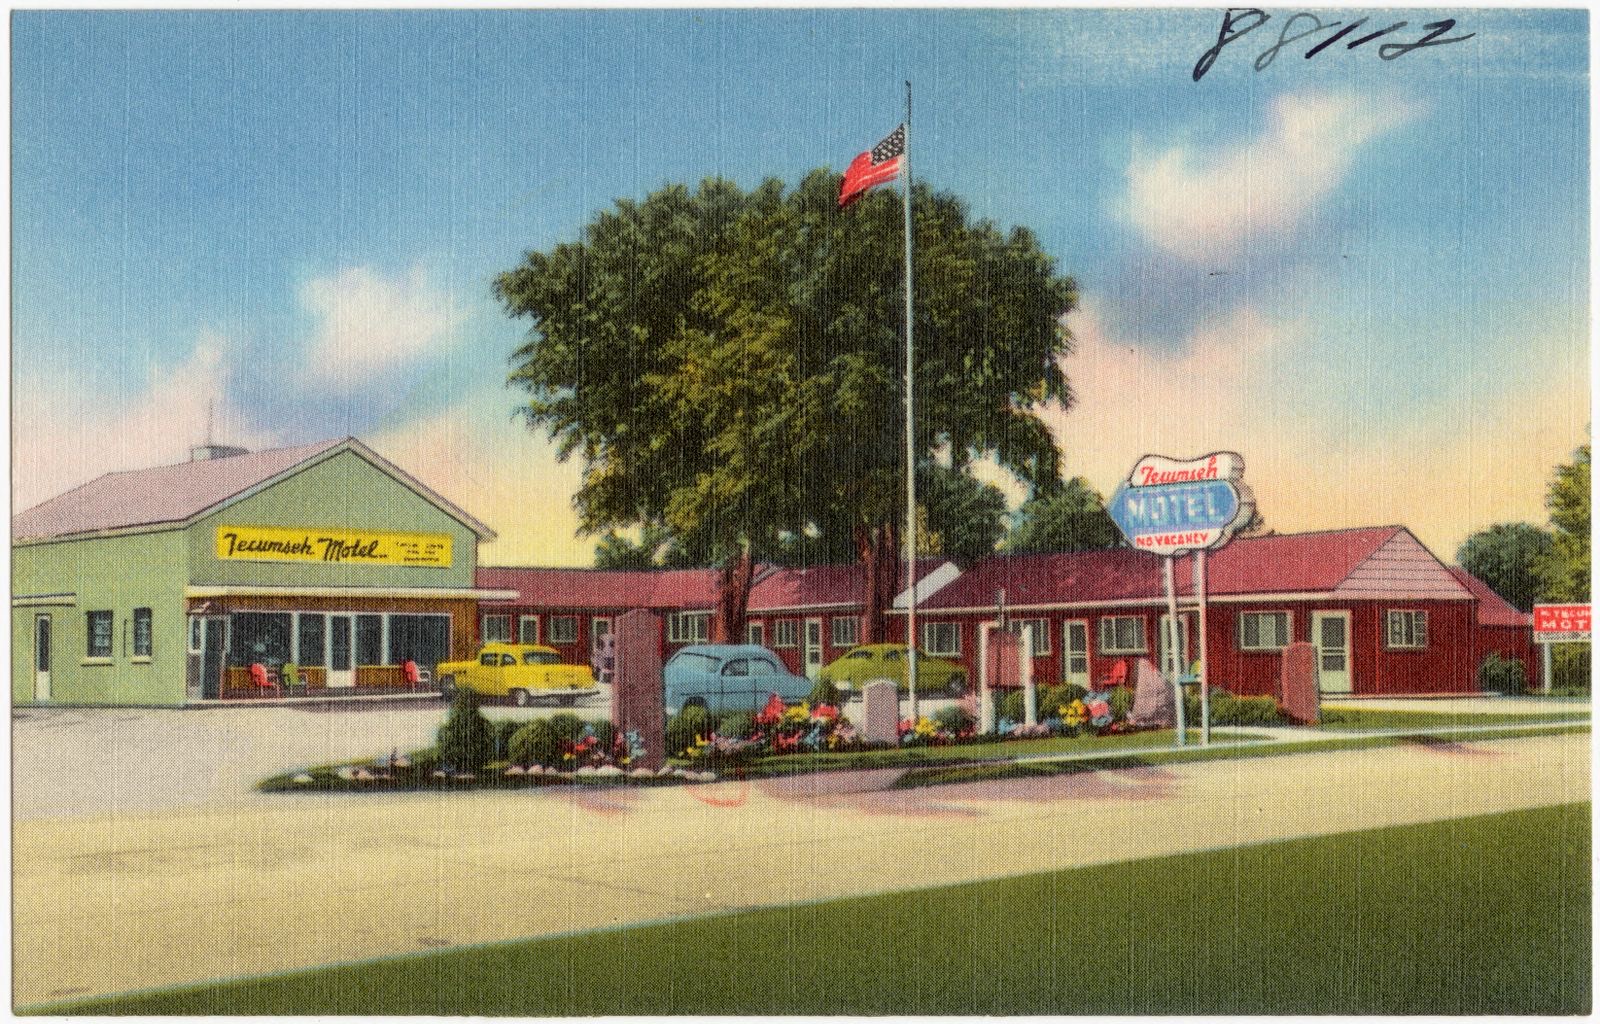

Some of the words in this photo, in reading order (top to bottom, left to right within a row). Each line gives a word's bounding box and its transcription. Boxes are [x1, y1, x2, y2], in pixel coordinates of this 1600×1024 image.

[1140, 455, 1218, 486] Tecumseh
[1127, 490, 1224, 527] MOTEL
[223, 532, 313, 556] Tecumseh
[317, 536, 385, 562] Motel
[1135, 535, 1153, 548] NO
[1155, 532, 1210, 547] VACANCY
